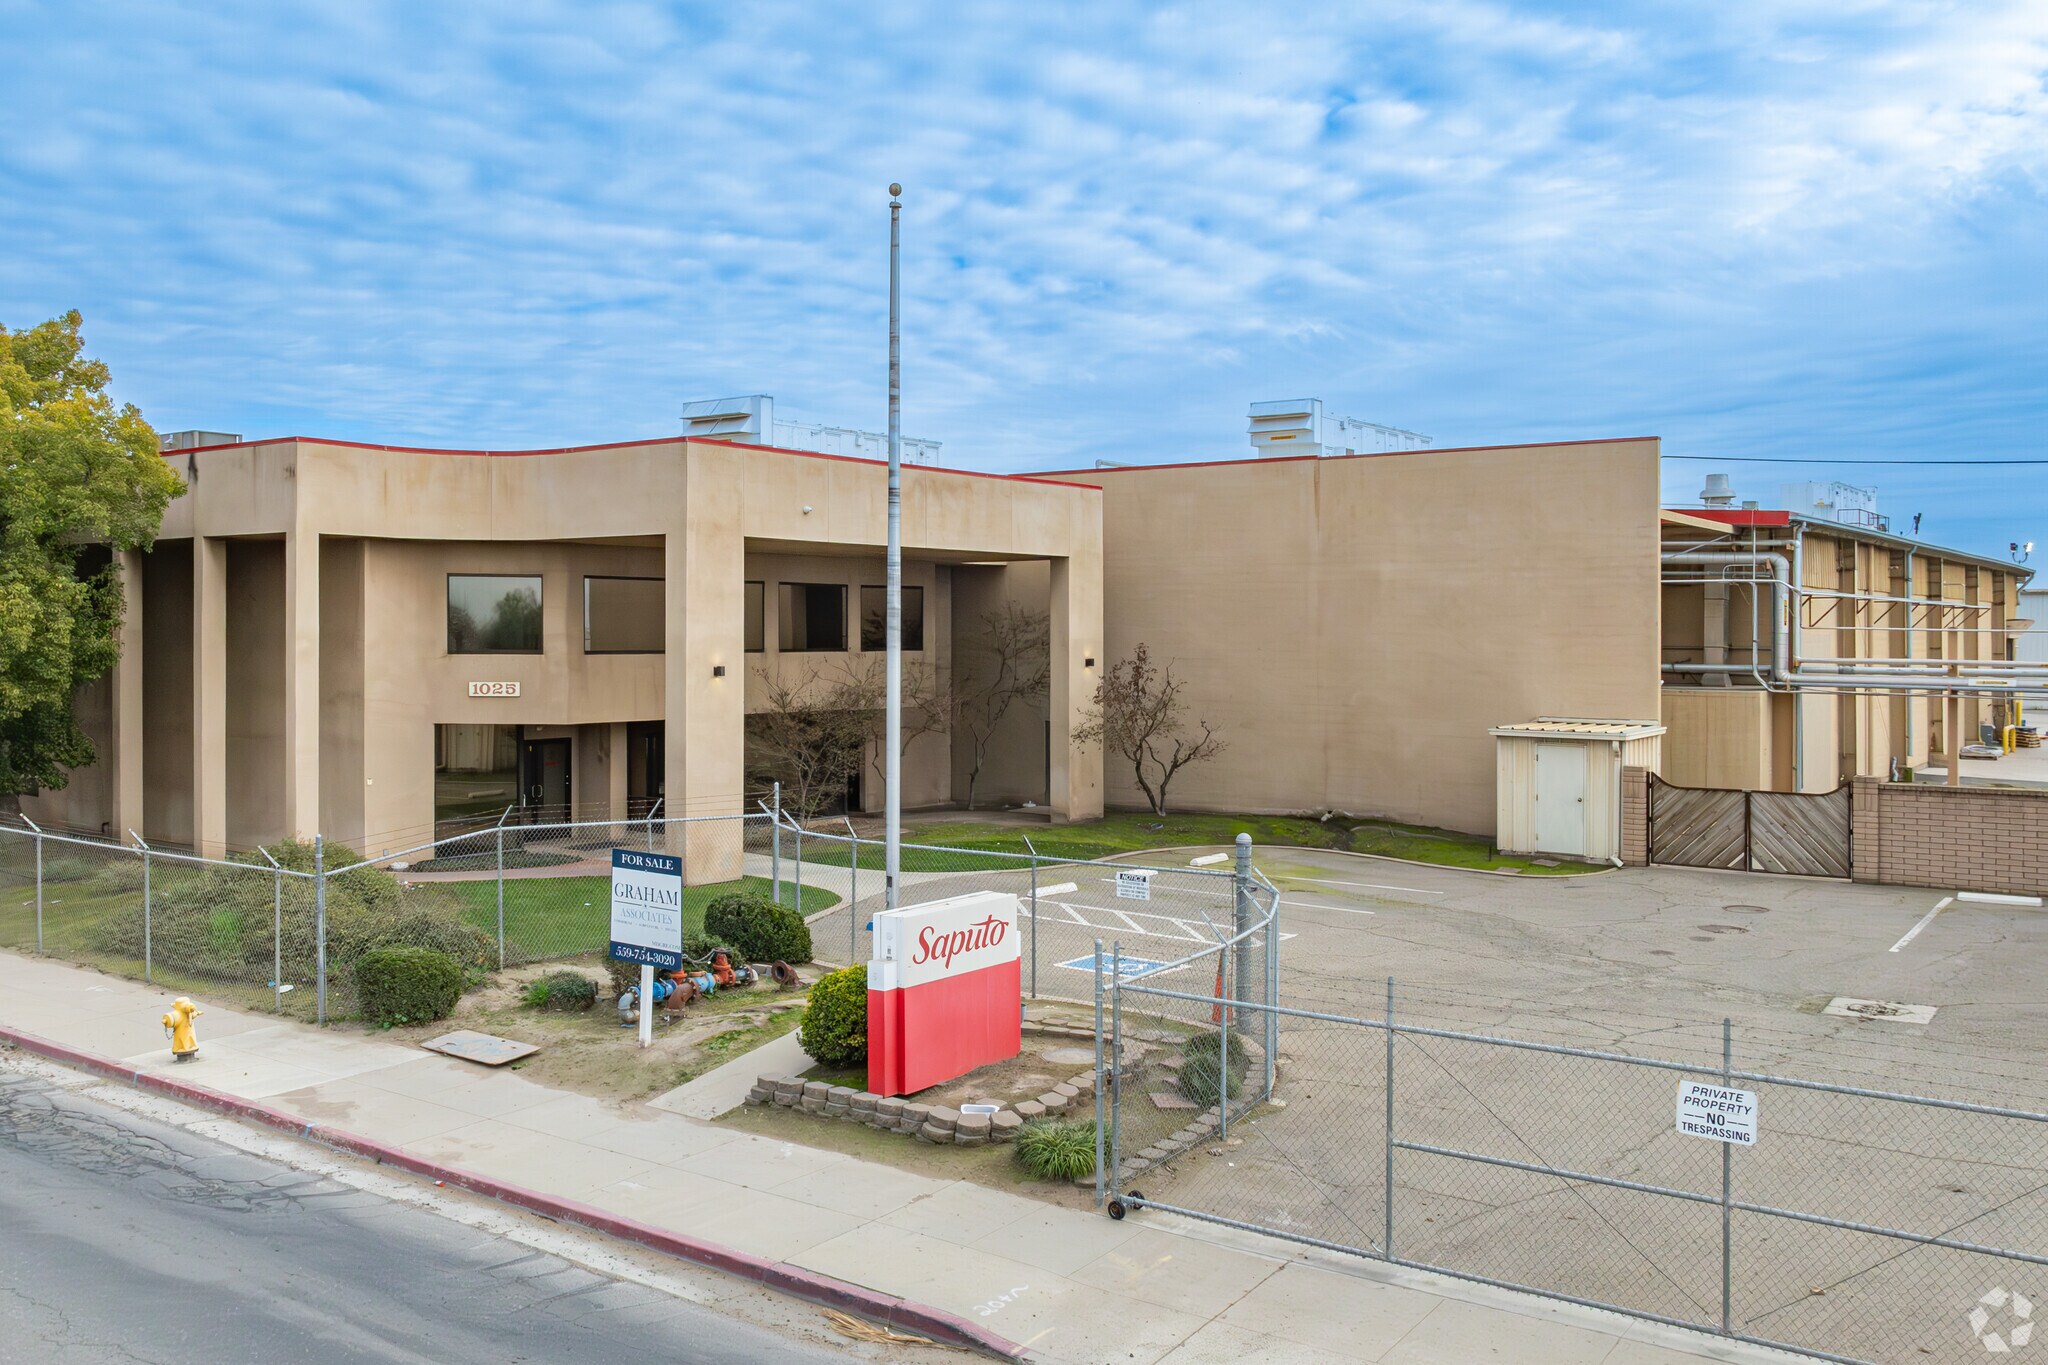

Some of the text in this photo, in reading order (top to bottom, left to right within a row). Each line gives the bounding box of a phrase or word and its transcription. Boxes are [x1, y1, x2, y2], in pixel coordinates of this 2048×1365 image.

[472, 683, 517, 695] 1025
[621, 853, 674, 871] FOR SALE
[1122, 874, 1144, 882] NOTICE
[614, 882, 678, 906] GRAHAM
[621, 907, 673, 925] ASSOCIATES
[912, 914, 1009, 969] Saputo
[615, 946, 676, 966] 559-754-3020
[1692, 1086, 1744, 1103] PRIVATE
[1684, 1096, 1752, 1115] PROPERTY
[1706, 1112, 1725, 1126] NO
[1682, 1121, 1750, 1142] TRESPASSING
